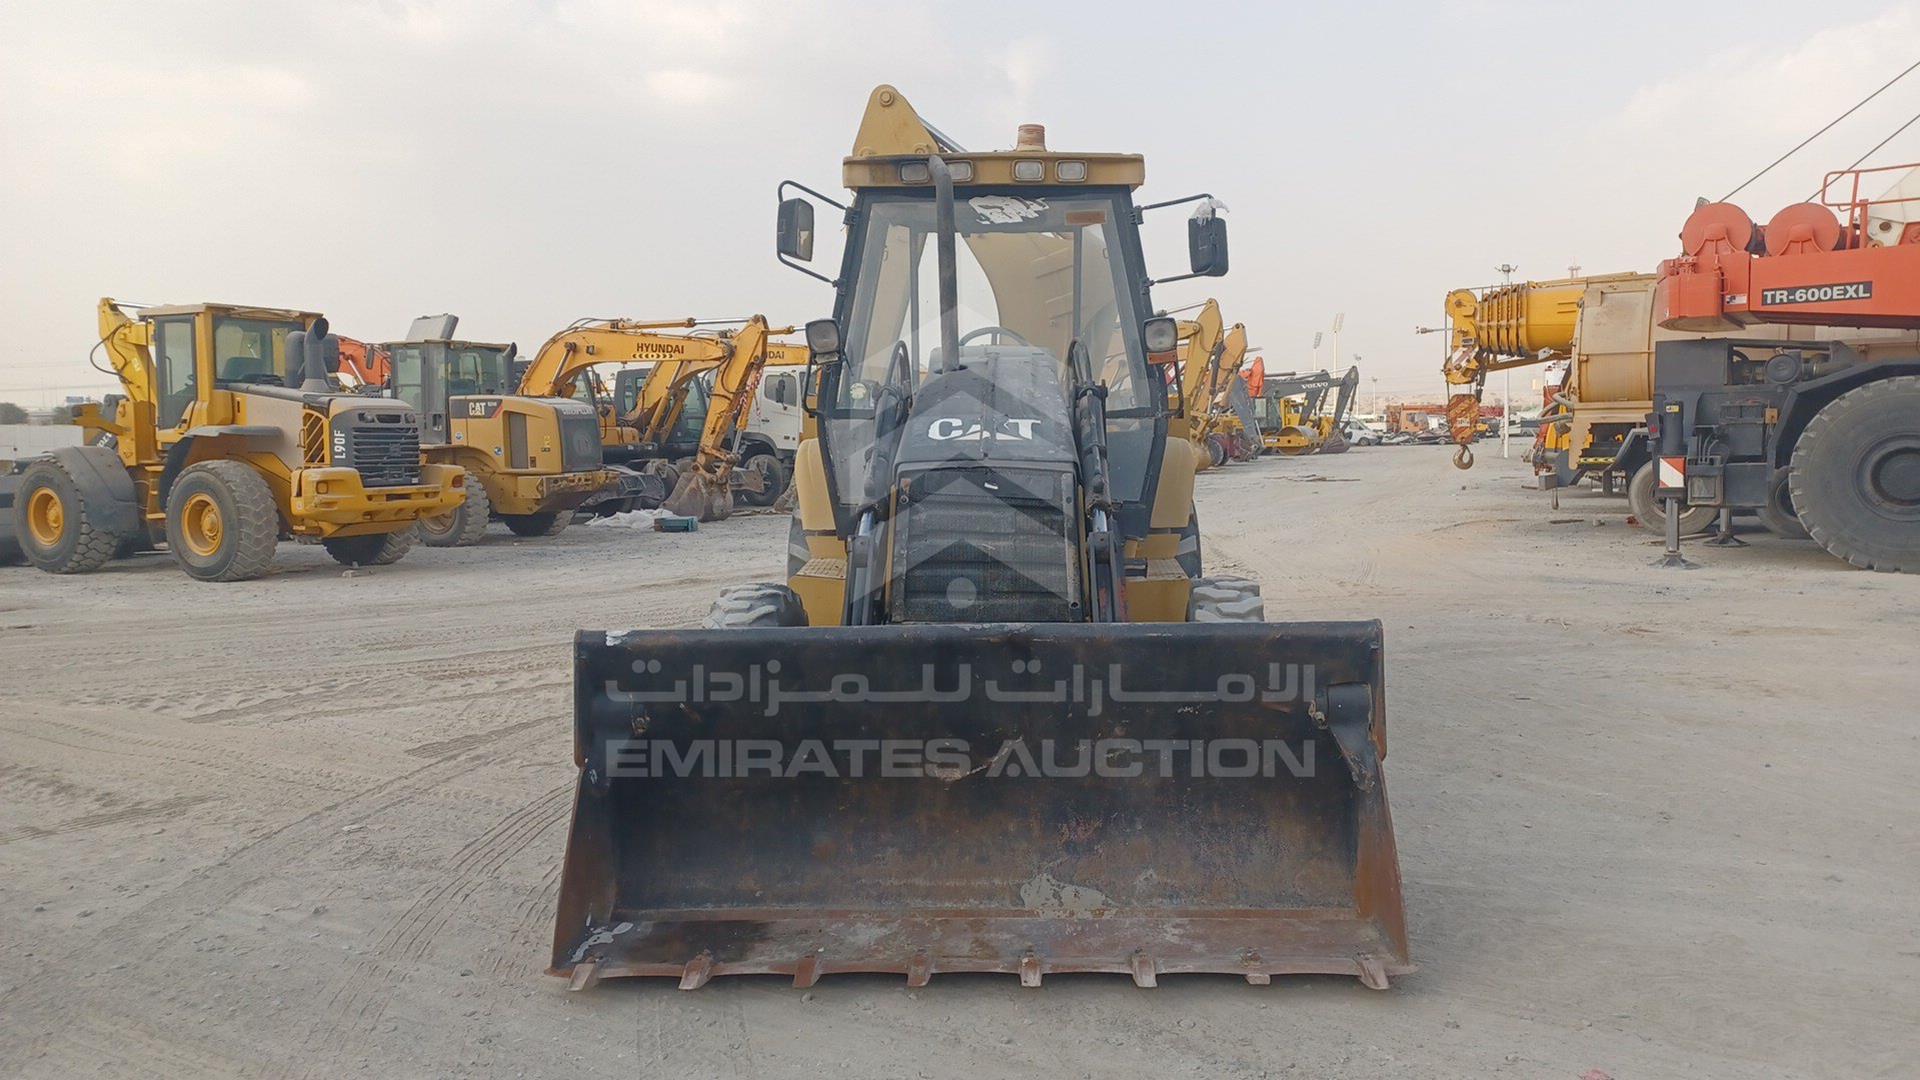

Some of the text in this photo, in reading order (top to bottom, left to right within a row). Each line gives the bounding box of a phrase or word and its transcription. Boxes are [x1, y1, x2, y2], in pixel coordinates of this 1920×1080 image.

[1763, 284, 1871, 305] TR-600EXL
[636, 342, 685, 354] HYUNDAI
[1301, 381, 1329, 390] VOLVO
[468, 402, 486, 416] CAT
[334, 430, 347, 459] L90F
